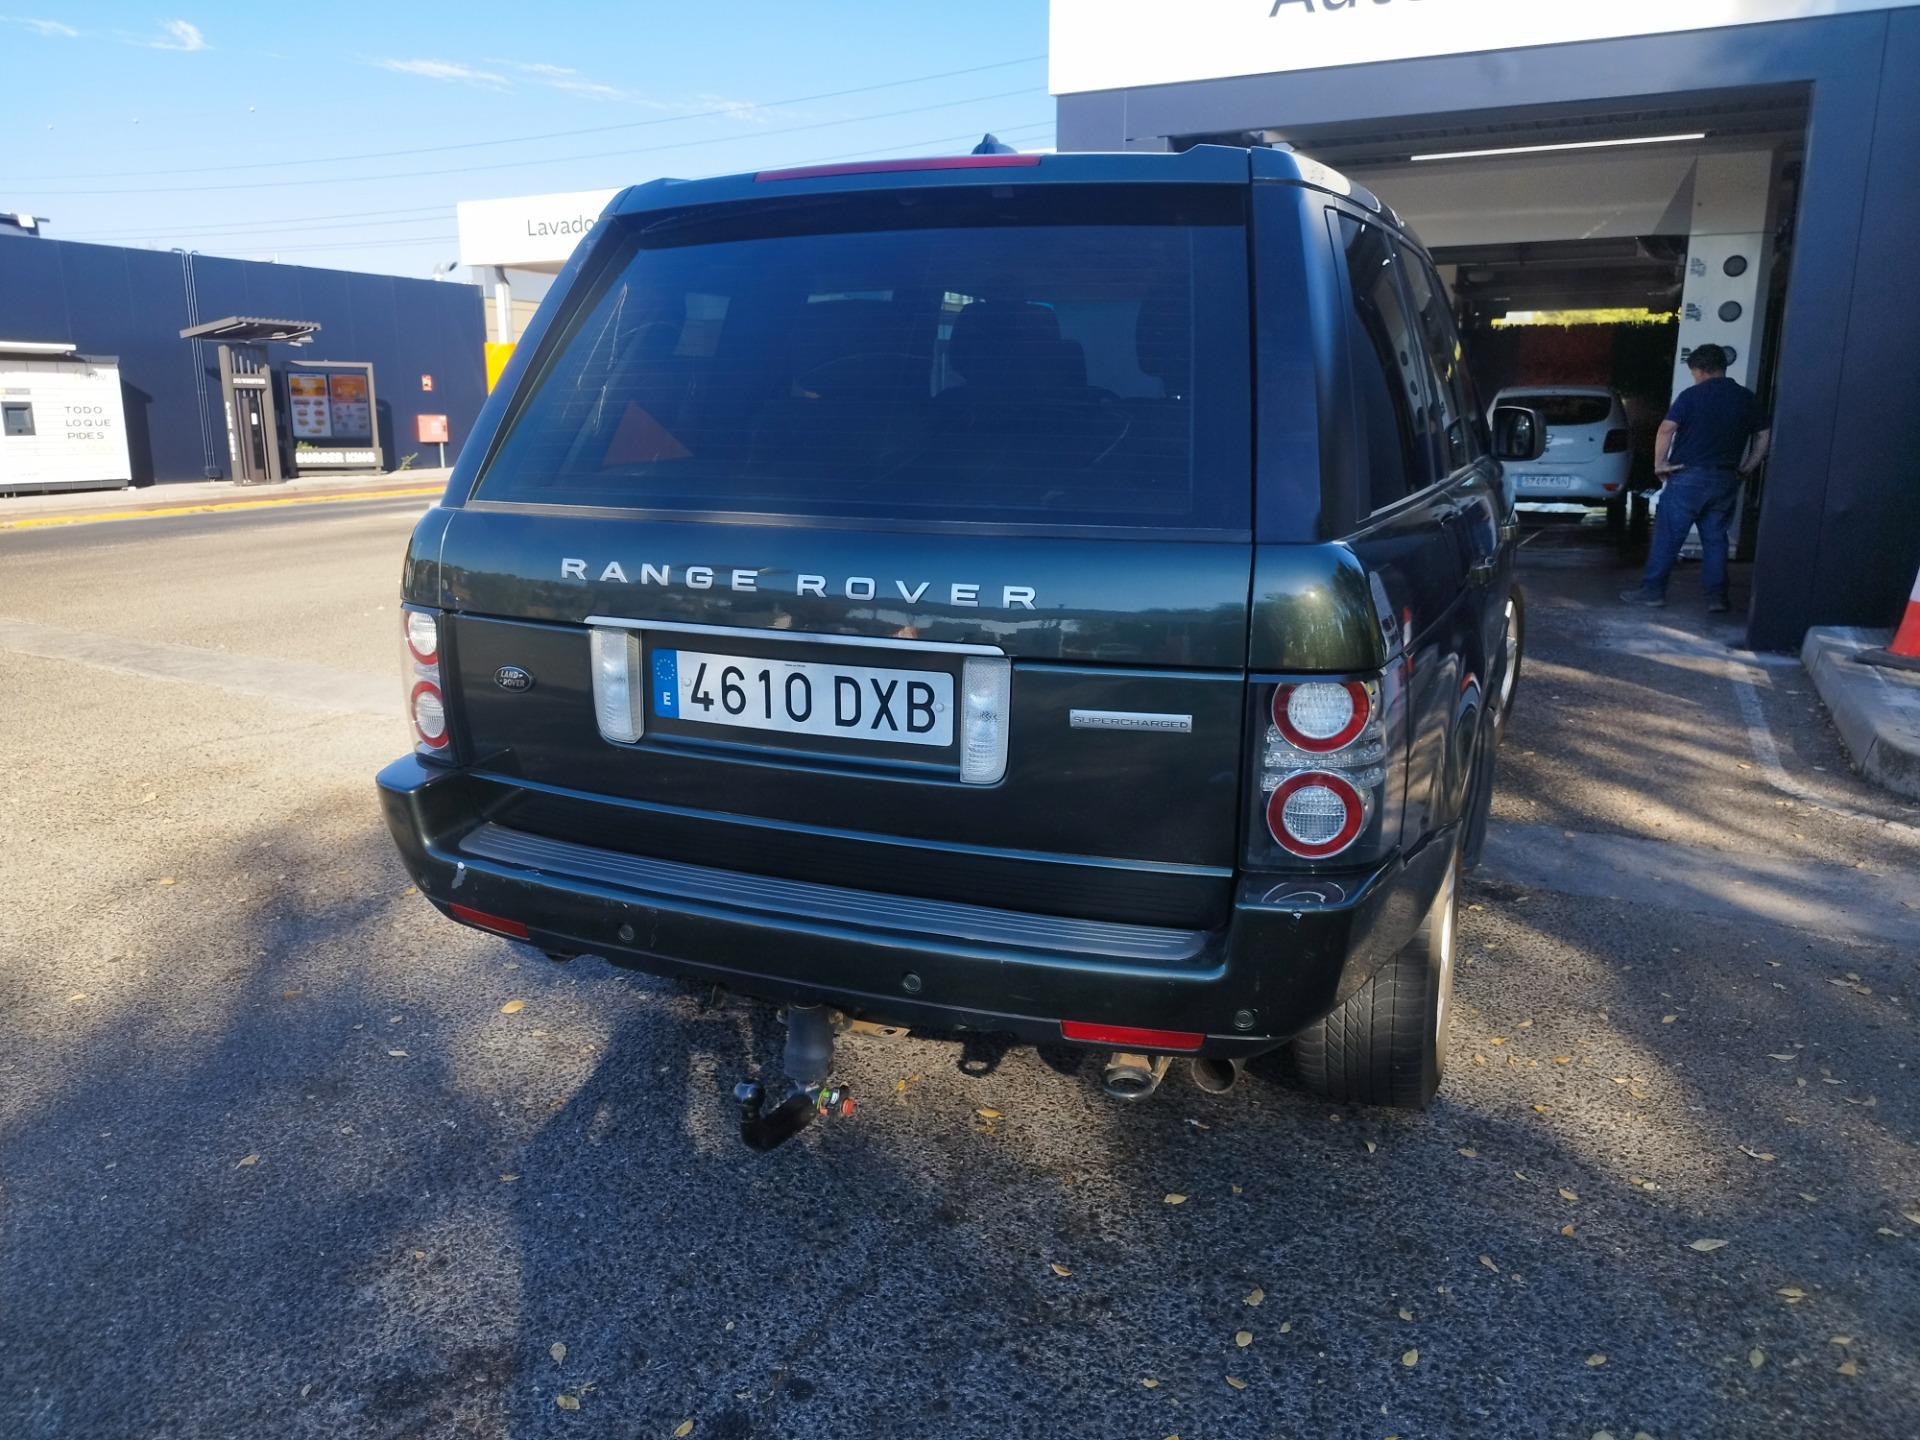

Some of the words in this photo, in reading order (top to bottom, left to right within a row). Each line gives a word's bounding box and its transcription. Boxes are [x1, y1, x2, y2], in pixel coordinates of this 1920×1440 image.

[64, 406, 102, 415] TODO
[67, 432, 104, 440] PIDES
[561, 557, 759, 592] RANGE
[796, 574, 1037, 610] ROVER
[663, 691, 671, 706] E
[690, 662, 812, 723] 4610
[834, 675, 936, 733] DXB
[1073, 716, 1189, 729] SUPERCHARGED
